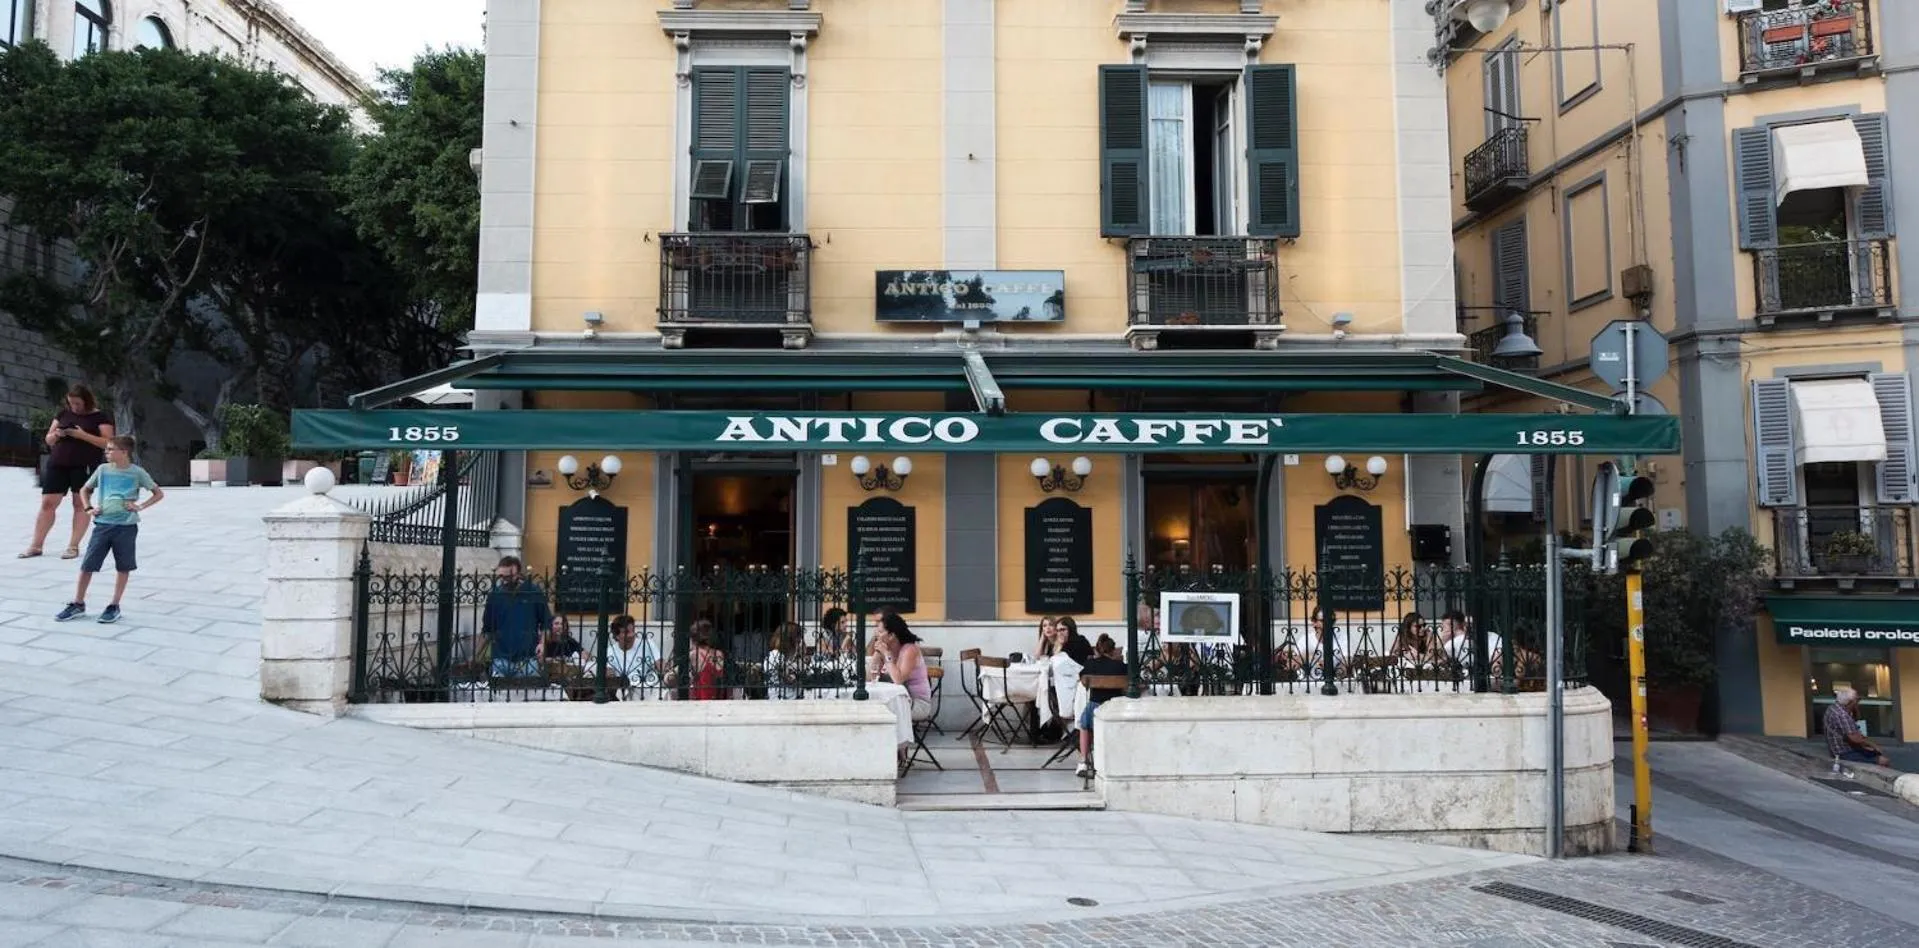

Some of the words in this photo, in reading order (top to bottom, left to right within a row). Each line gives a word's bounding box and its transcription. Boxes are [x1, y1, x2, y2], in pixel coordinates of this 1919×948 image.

[884, 282, 969, 297] ANTICO
[388, 426, 460, 441] 1855
[715, 416, 980, 443] ANTICO
[1516, 430, 1585, 445] 1855
[1789, 626, 1861, 638] Paoletti
